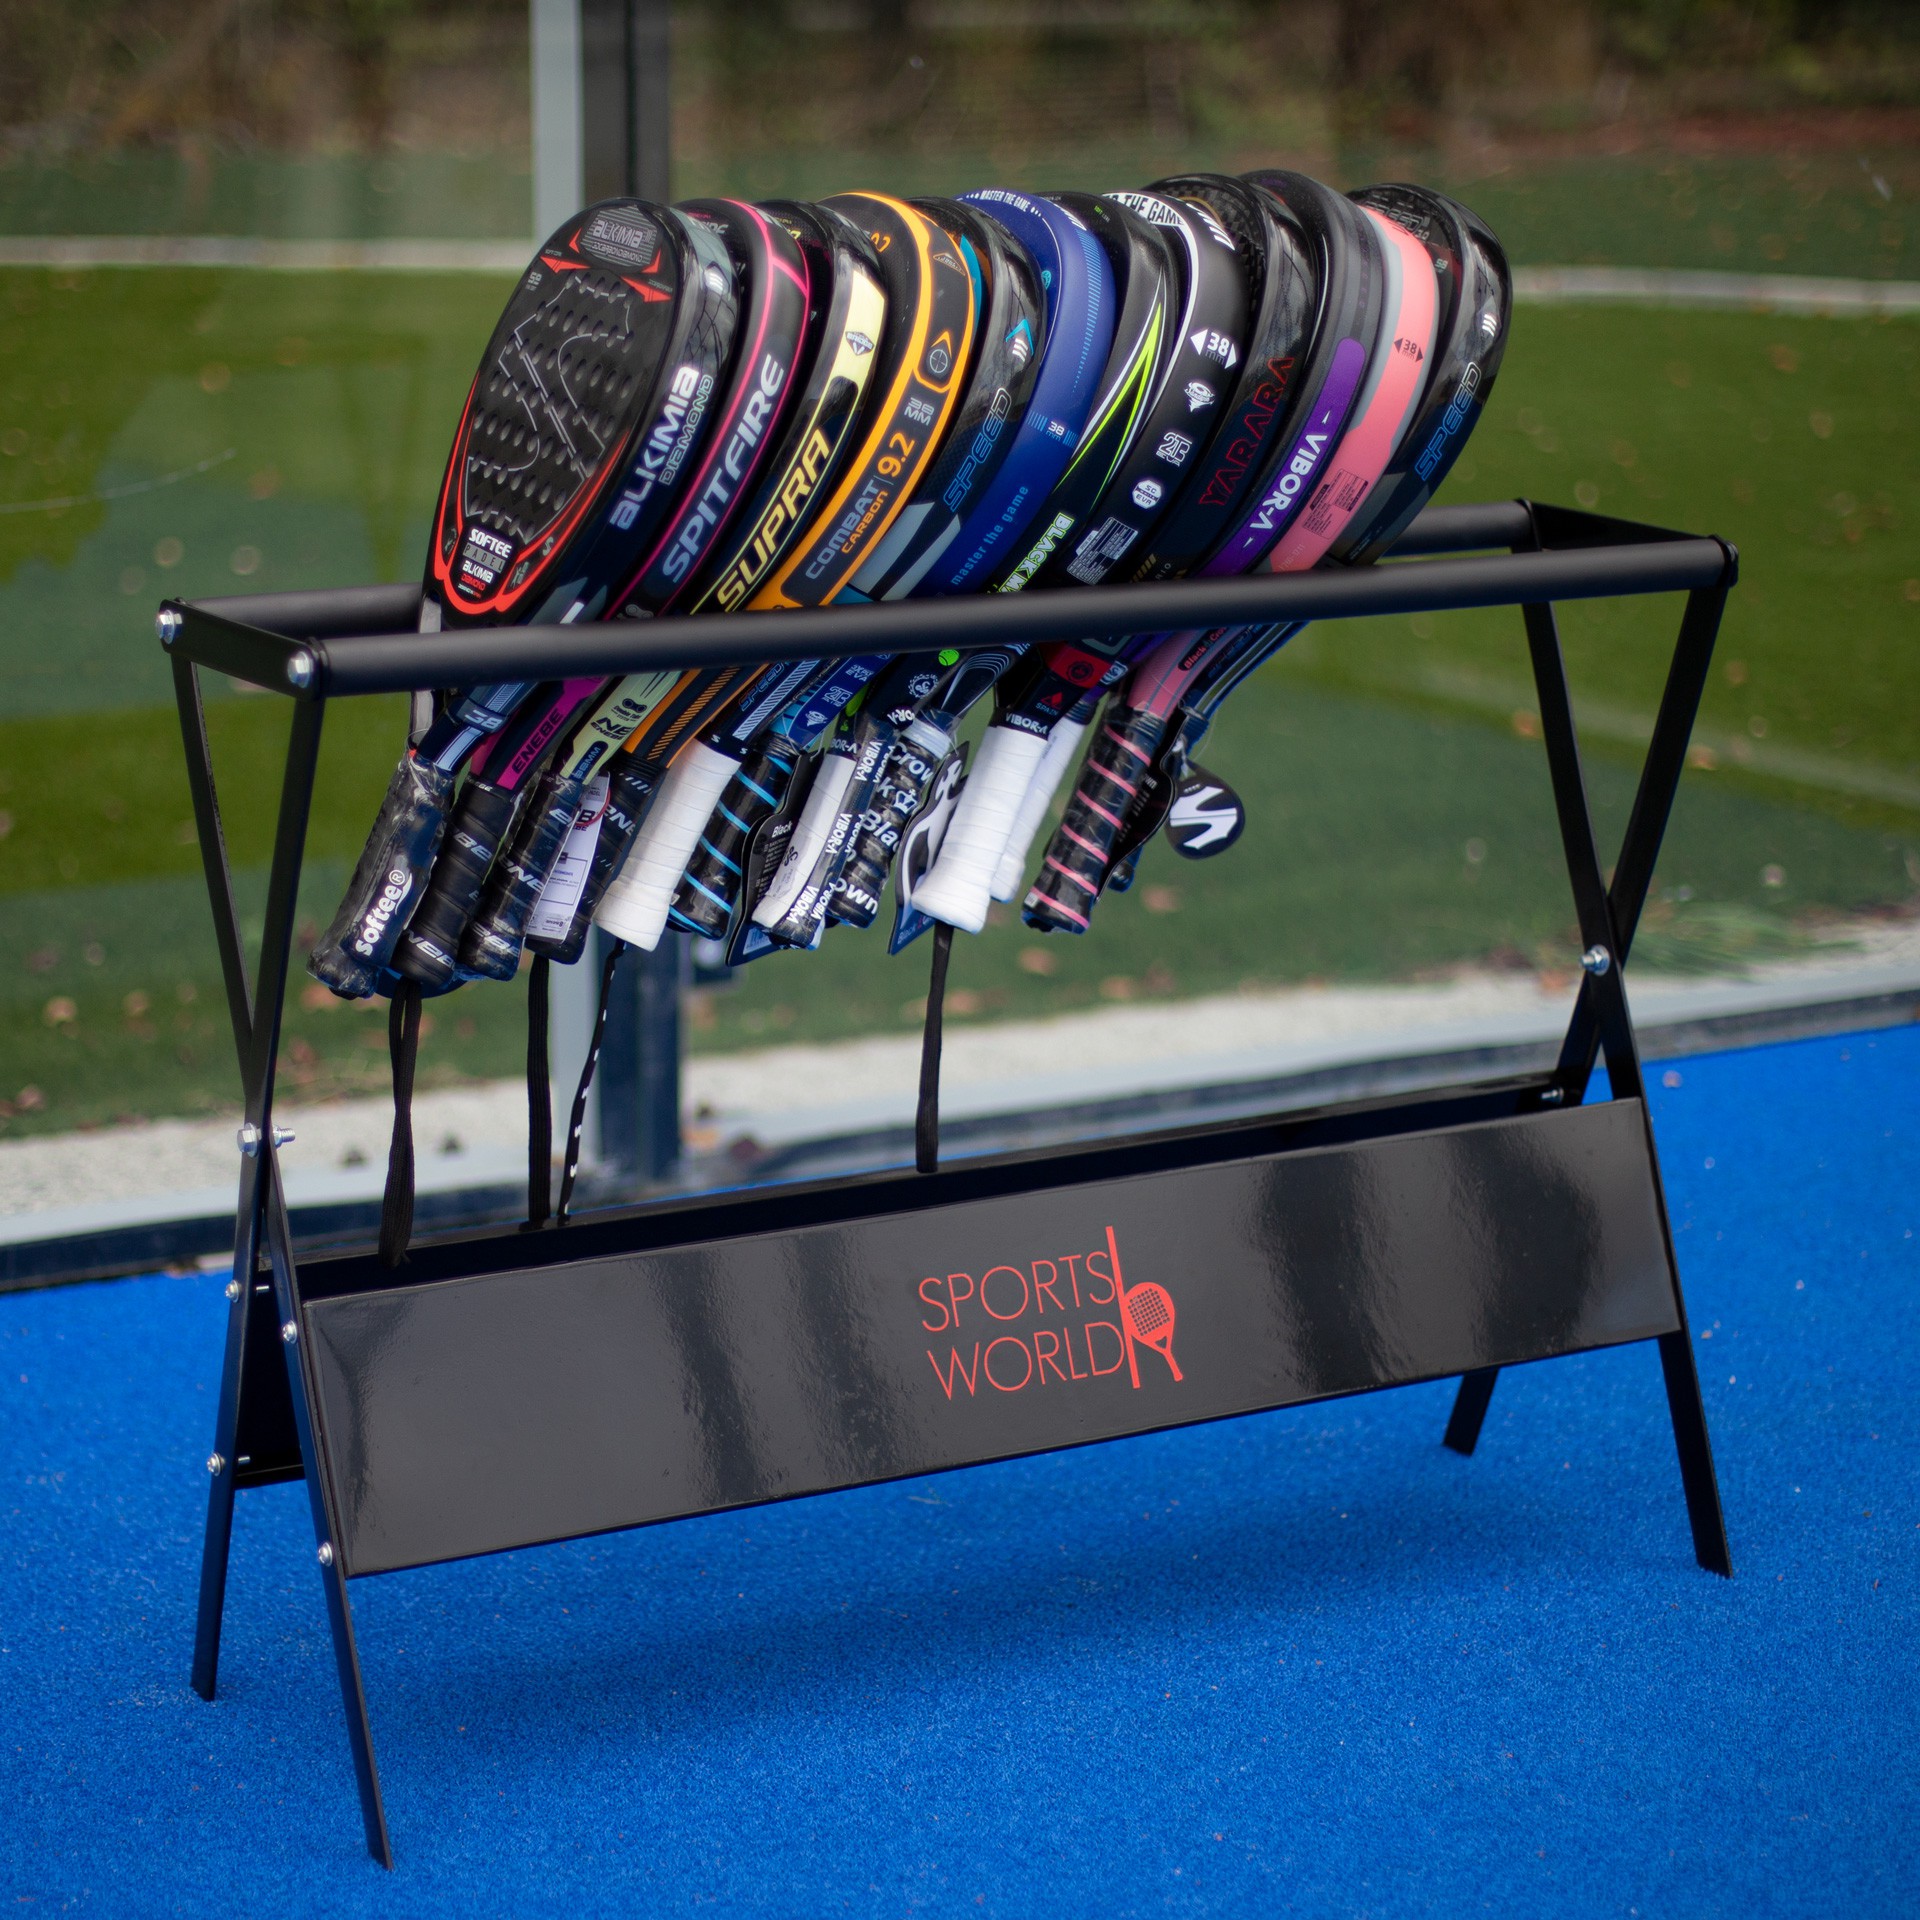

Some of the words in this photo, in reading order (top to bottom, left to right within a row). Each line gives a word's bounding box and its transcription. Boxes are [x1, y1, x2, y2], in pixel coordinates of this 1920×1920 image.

[981, 189, 1005, 201] MASTER
[1004, 192, 1015, 204] THE
[1014, 197, 1031, 212] GAME
[1207, 331, 1228, 354] 38
[1402, 338, 1418, 354] 38
[904, 407, 932, 426] MM
[907, 396, 935, 415] 38
[1415, 361, 1482, 482] SPEED
[659, 374, 714, 486] DIAMOND
[1048, 420, 1065, 436] 38
[661, 354, 785, 583] SPITFIRE
[943, 387, 1012, 513] SPEED
[1135, 493, 1152, 506] EVA
[1250, 431, 1327, 532] VIBOR-A
[716, 428, 830, 613] SUPRA
[805, 479, 881, 580] COMBAT
[877, 432, 915, 477] 9.2
[842, 490, 889, 554] CARBON
[469, 528, 512, 558] SOFTEE
[951, 545, 988, 587] master
[985, 523, 1004, 545] the
[1001, 485, 1029, 524] game
[1015, 512, 1075, 582] BLACK
[464, 544, 504, 572] PADEL
[845, 669, 868, 682] EVA
[1184, 645, 1207, 669] Black
[1006, 712, 1048, 735] VIBOR-A
[1035, 702, 1058, 716] SPAIN
[512, 707, 563, 774] ENEBE
[854, 740, 883, 782] VIBOR-A
[772, 821, 793, 838] Black
[825, 813, 852, 855] VIBOR-A
[786, 885, 820, 924] VIBOR-A
[918, 1251, 1116, 1332] SPORTS
[927, 1321, 1124, 1400] WORLD
